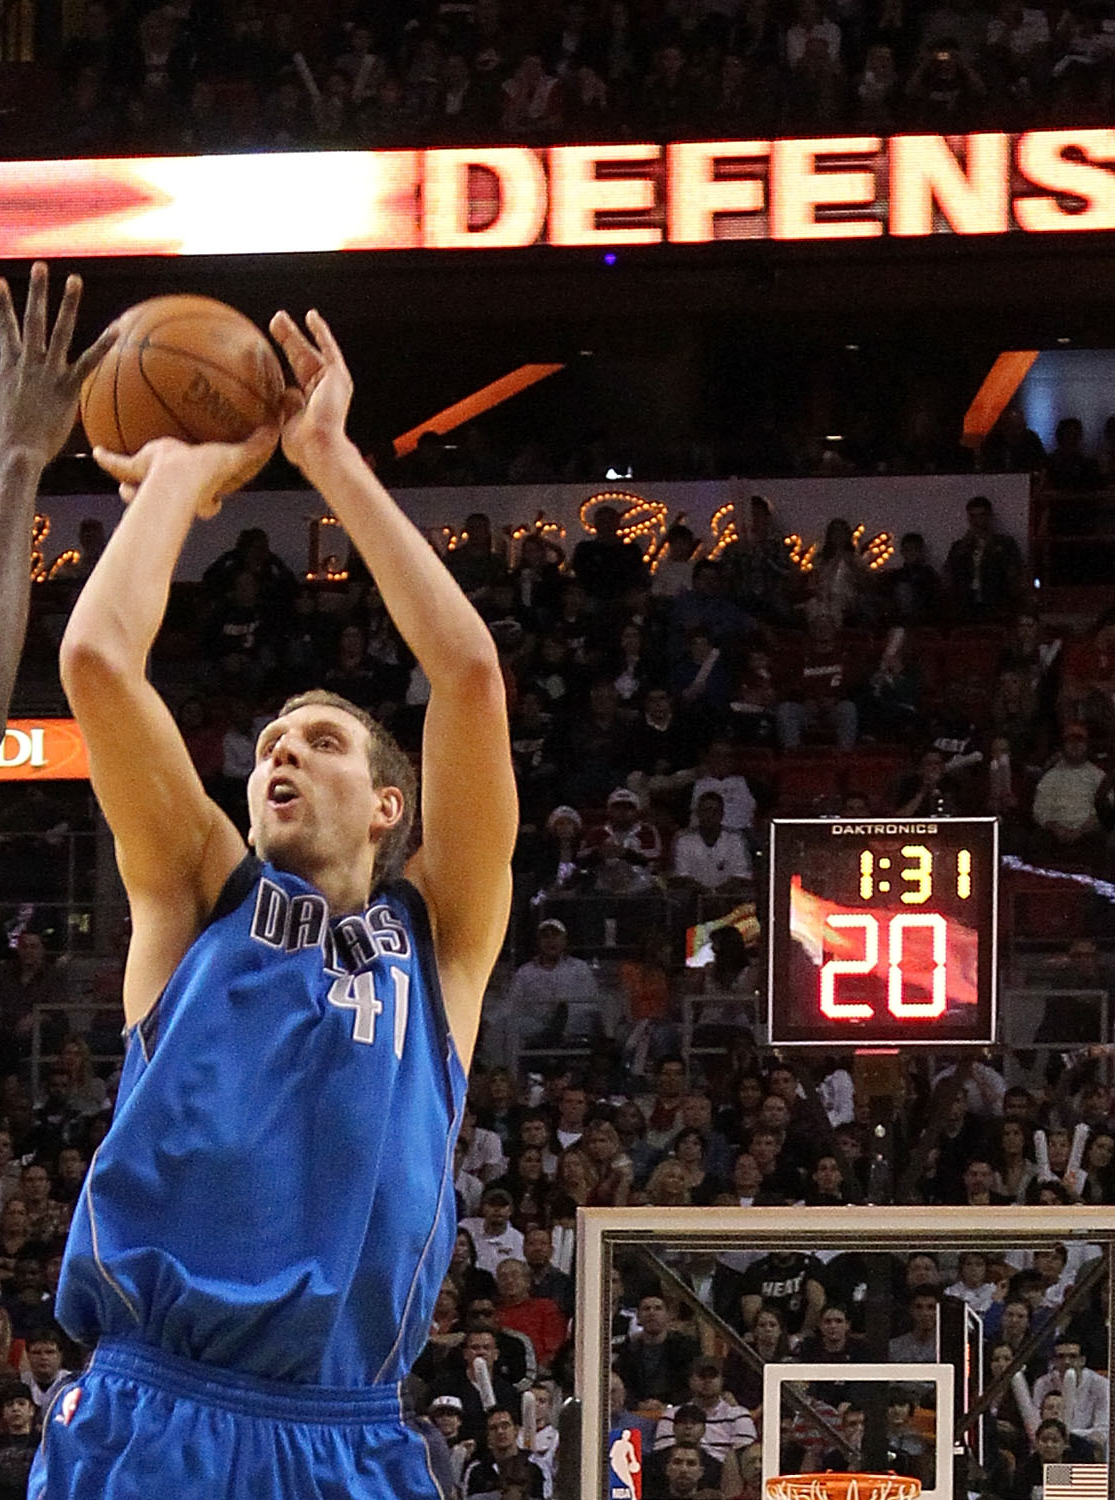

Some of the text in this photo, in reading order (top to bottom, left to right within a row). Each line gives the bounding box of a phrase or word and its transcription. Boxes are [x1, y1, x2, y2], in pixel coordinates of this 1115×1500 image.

[424, 129, 1115, 248] DEFENS
[831, 824, 938, 835] DAKTRONICS
[859, 845, 971, 904] 1:31
[250, 877, 412, 976] DALAS
[820, 913, 947, 1019] 20
[328, 966, 410, 1060] 41
[762, 1271, 804, 1298] HEAT
